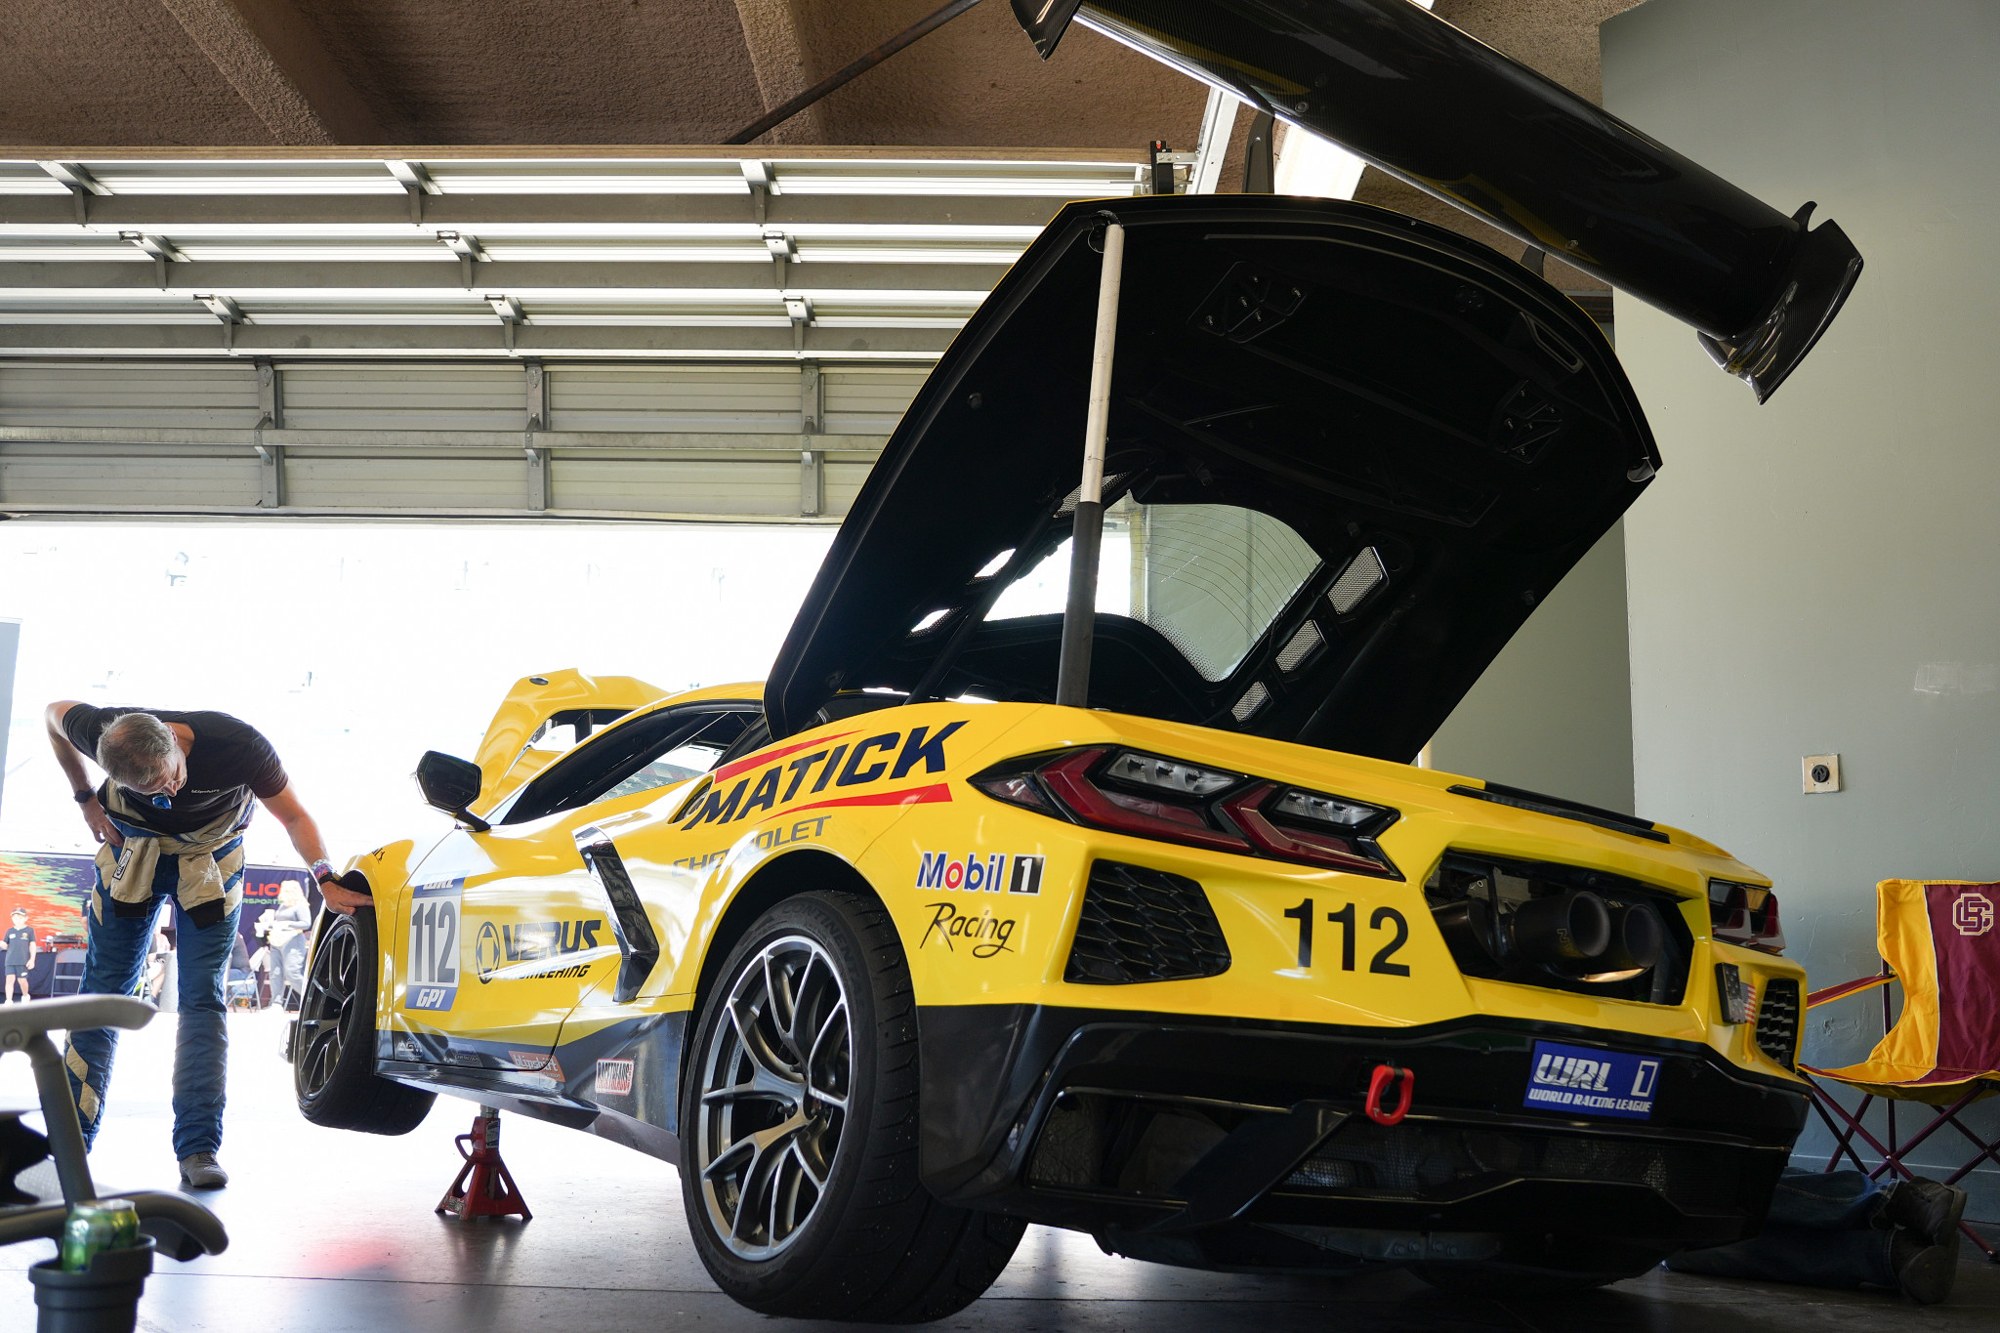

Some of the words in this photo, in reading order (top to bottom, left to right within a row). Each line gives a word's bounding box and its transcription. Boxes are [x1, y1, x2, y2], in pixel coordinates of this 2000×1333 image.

[680, 720, 970, 831] MATICK
[671, 815, 832, 877] CHEOLET
[915, 851, 1007, 892] Mobil
[411, 900, 456, 984] 112
[502, 919, 602, 962] VERUS
[919, 902, 1016, 959] Racing
[1283, 897, 1411, 978] 112
[416, 988, 447, 1009] GP1
[1528, 1087, 1573, 1104] WORLD
[1572, 1092, 1617, 1110] RACING
[1616, 1098, 1653, 1113] LEAGUE
[1533, 1053, 1612, 1092] WRL
[1631, 1059, 1659, 1098] 1
